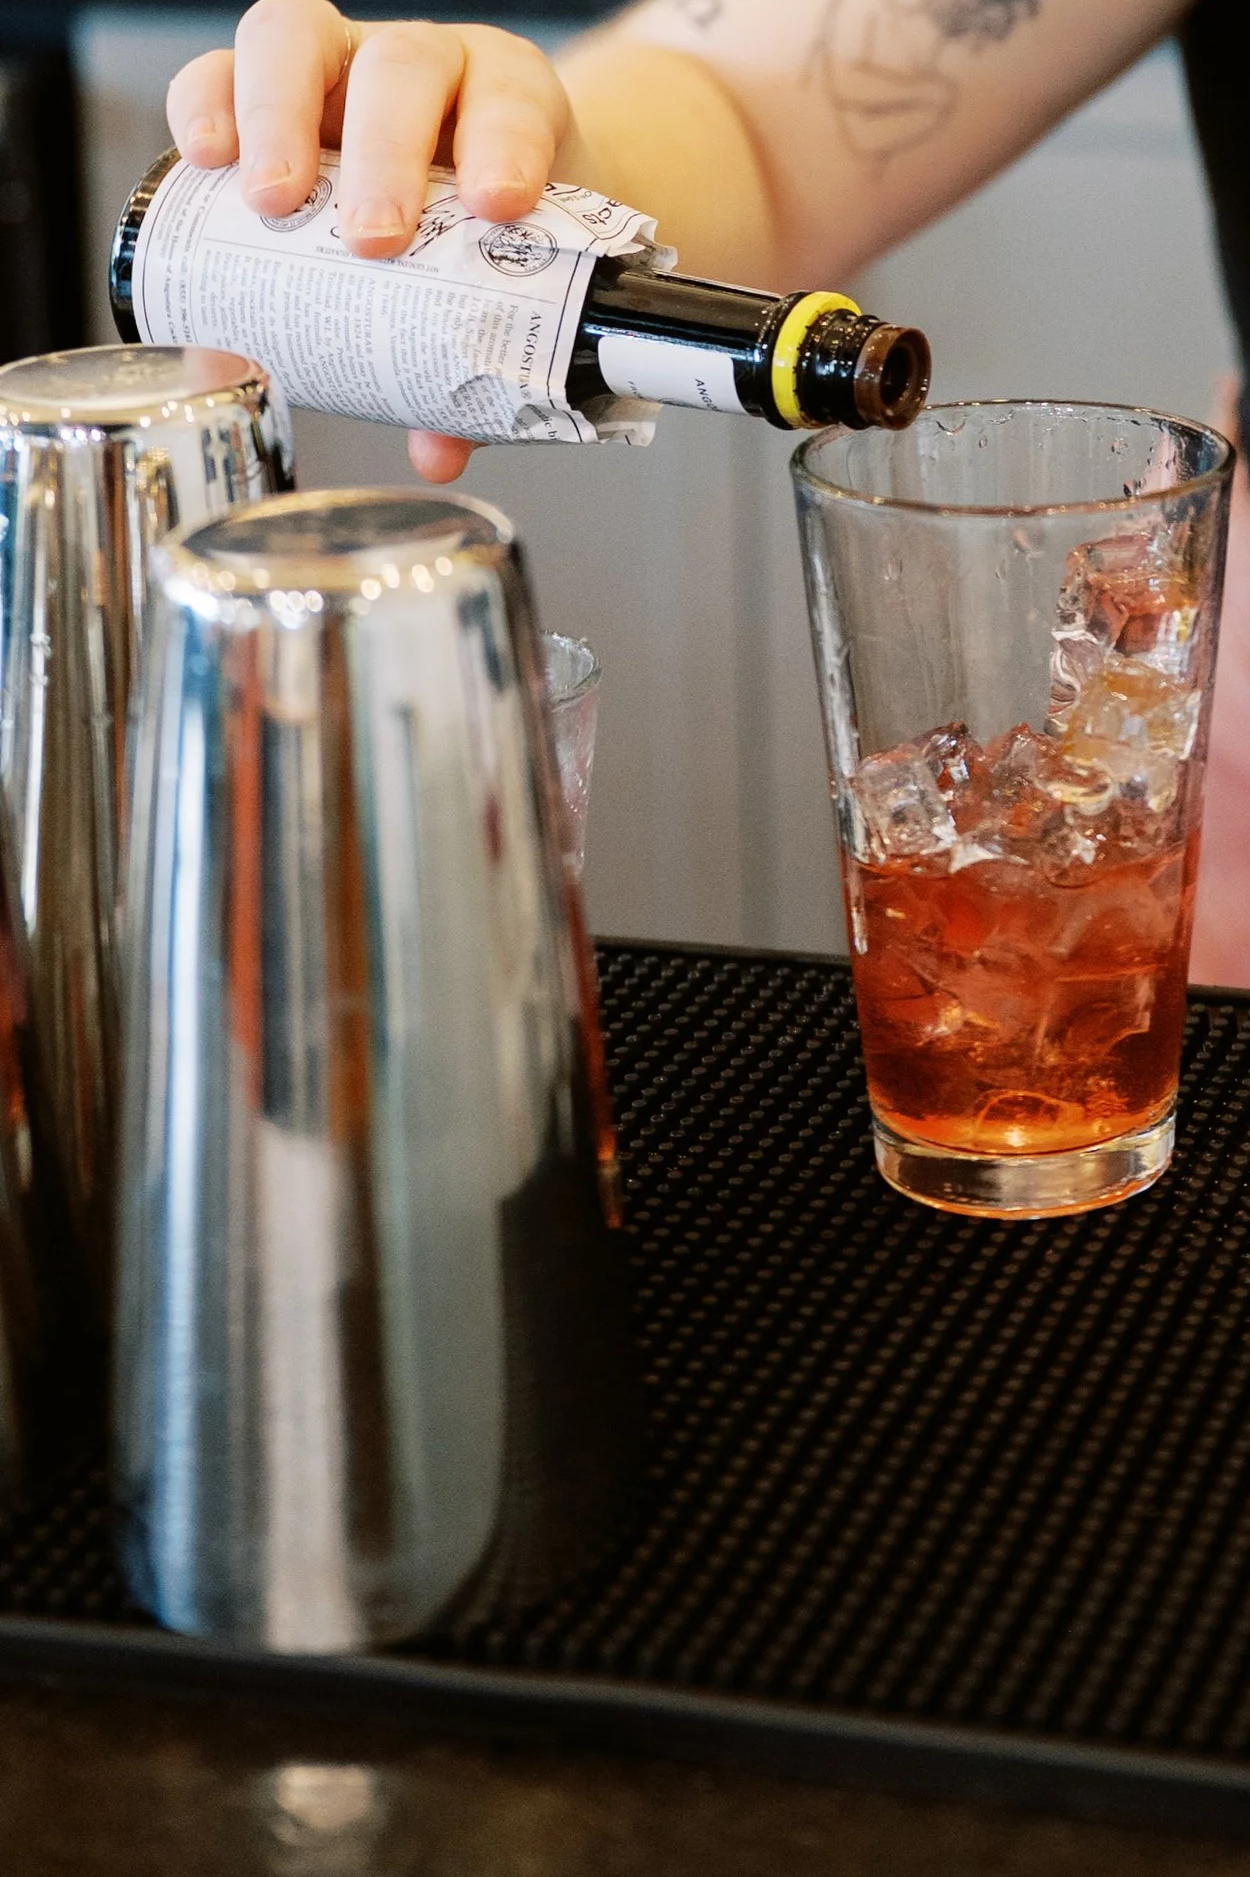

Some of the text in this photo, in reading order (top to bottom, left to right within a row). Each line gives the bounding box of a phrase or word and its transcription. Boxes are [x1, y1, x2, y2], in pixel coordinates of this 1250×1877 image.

[434, 289, 443, 307] and
[446, 292, 456, 306] the
[457, 294, 469, 309] but
[496, 301, 505, 312] of
[507, 305, 519, 321] For
[400, 310, 409, 325] the
[492, 314, 503, 329] this
[477, 329, 487, 344] the
[503, 323, 514, 337] the
[420, 341, 429, 355] the
[498, 339, 512, 365] better
